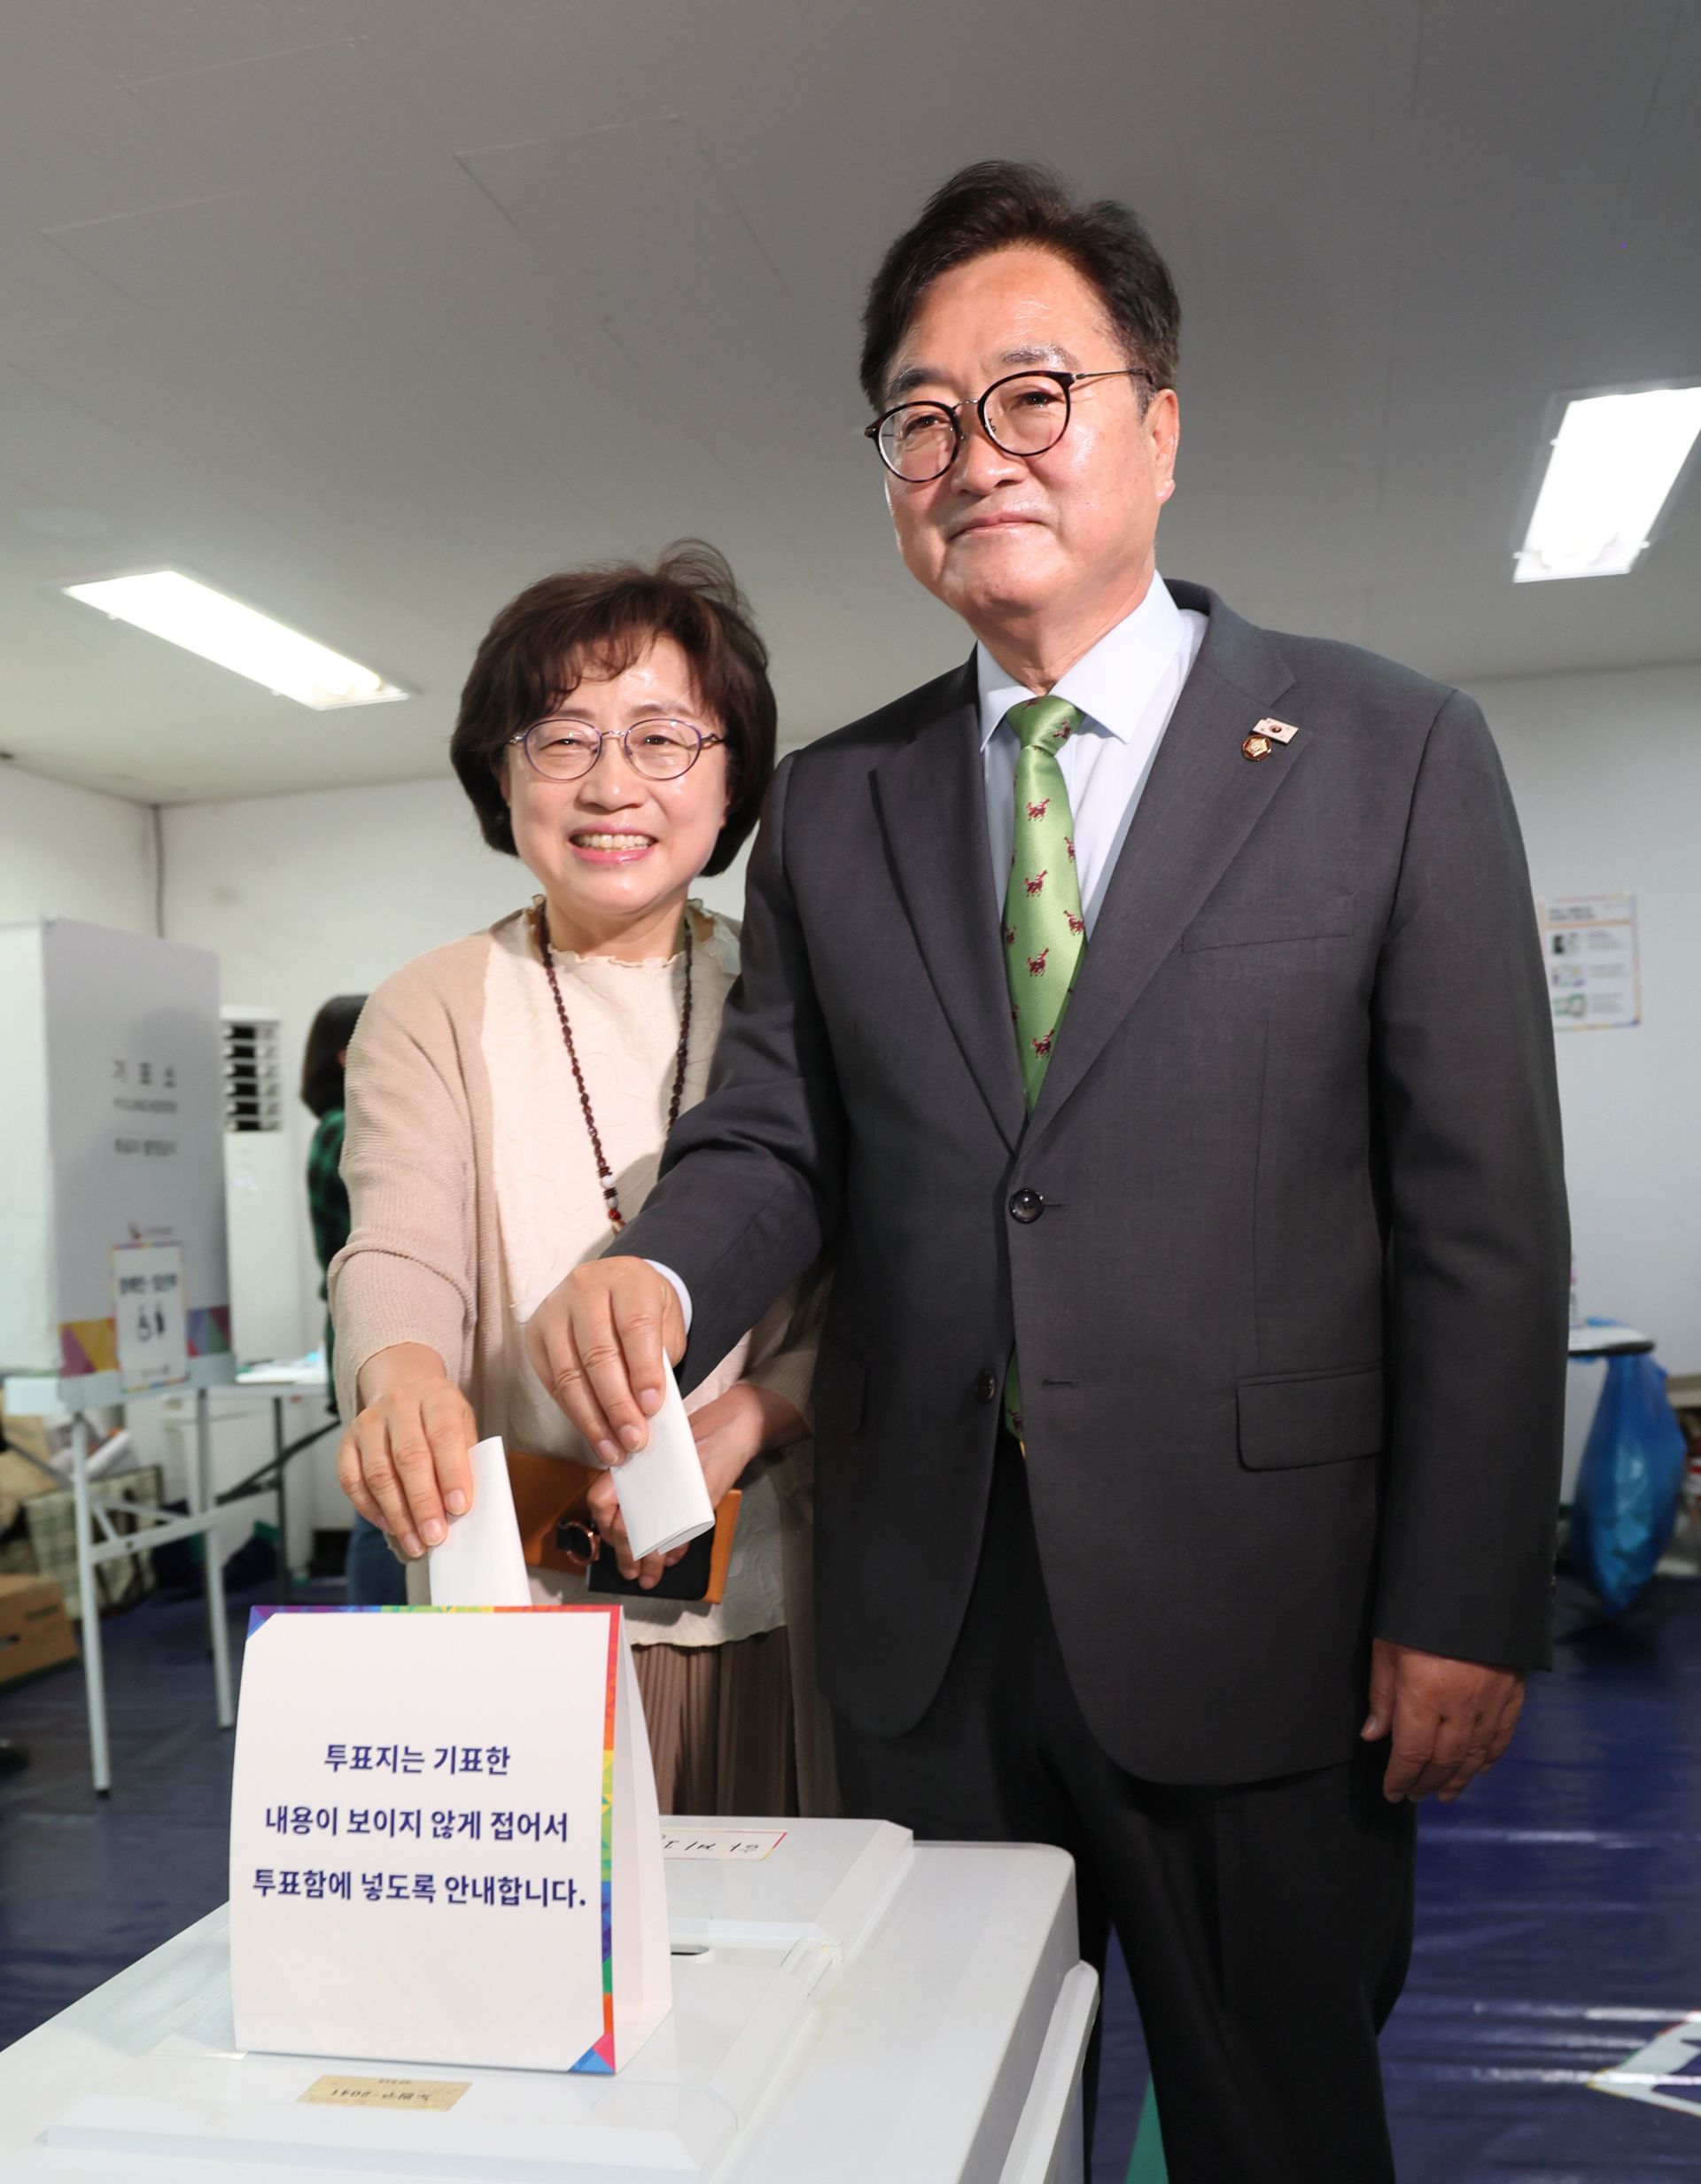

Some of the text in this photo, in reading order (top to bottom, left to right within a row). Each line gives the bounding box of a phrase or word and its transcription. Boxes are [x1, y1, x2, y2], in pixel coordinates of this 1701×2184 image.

[324, 1745, 510, 1775] 투표지는 기표한
[266, 1806, 567, 1842] 내용이 보이지 않게 접어서
[253, 1869, 586, 1908] 투표함에 넣도록 안내합니다.
